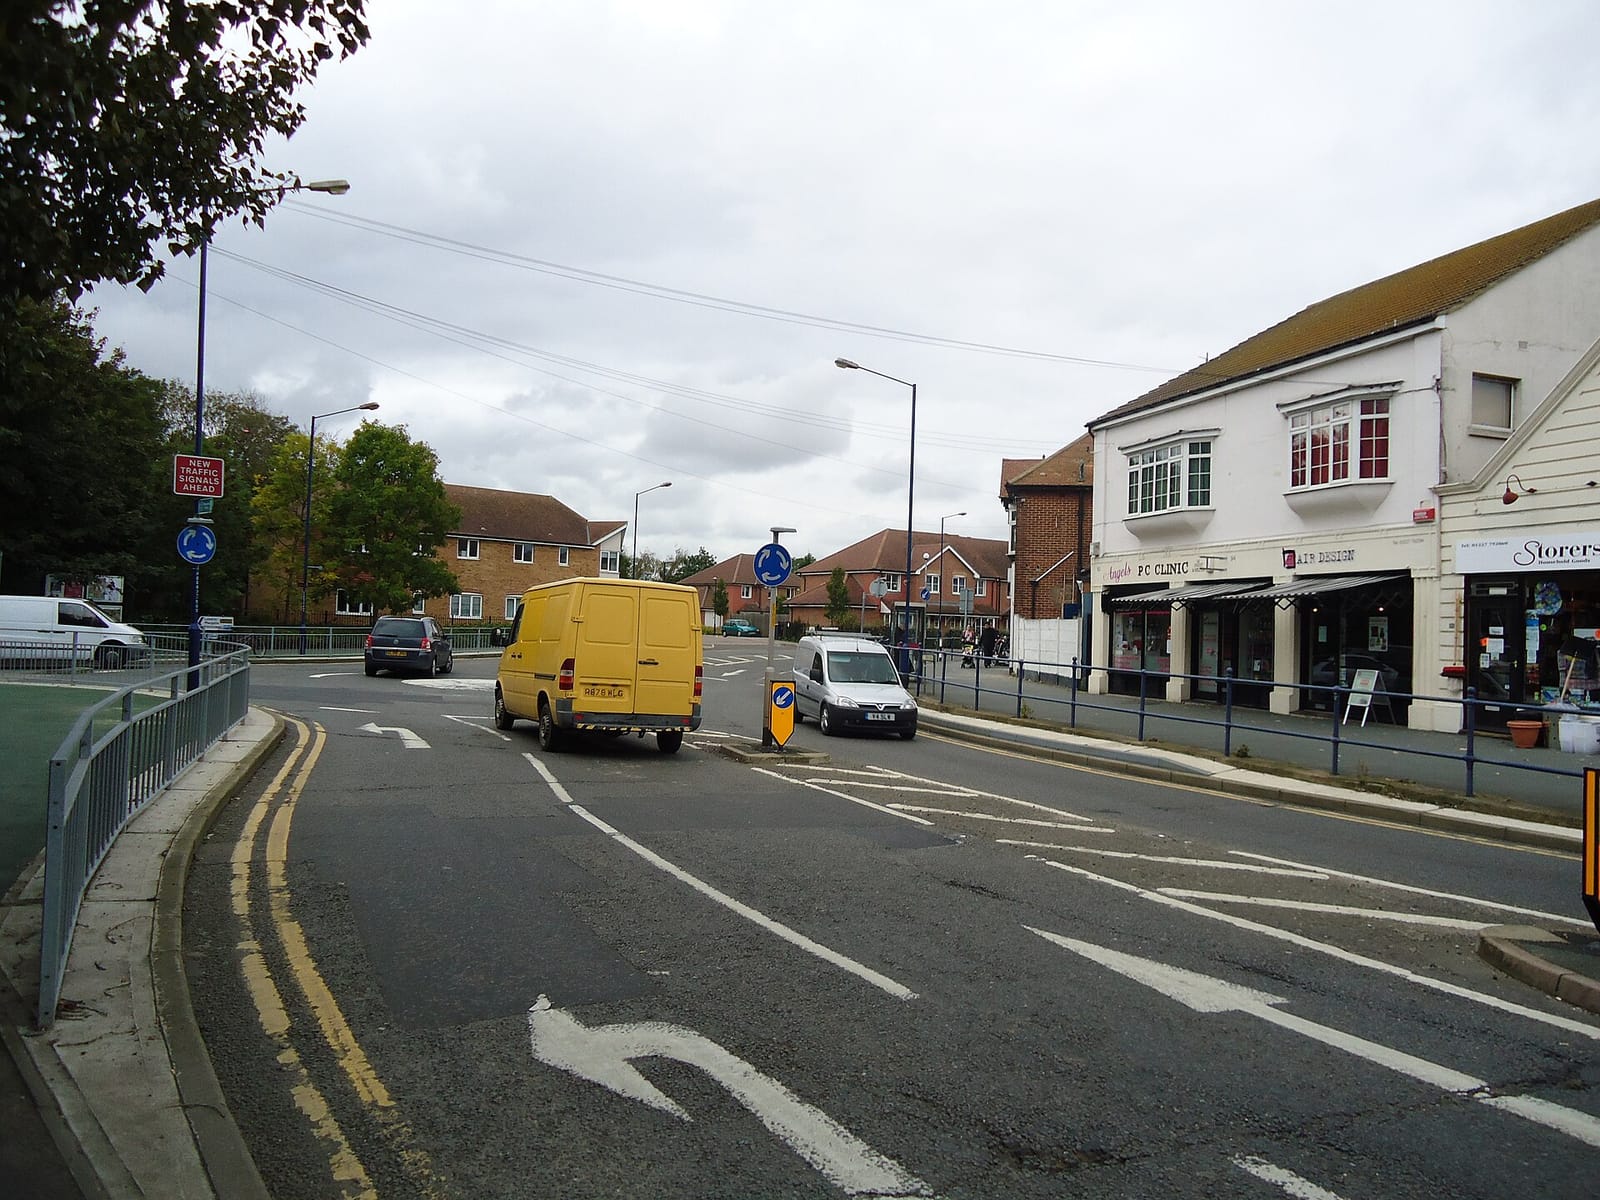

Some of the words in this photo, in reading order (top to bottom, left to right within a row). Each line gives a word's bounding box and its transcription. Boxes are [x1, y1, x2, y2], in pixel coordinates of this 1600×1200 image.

[189, 460, 210, 468] NEW
[180, 467, 218, 477] TRAFFIC
[179, 475, 219, 485] SIGNALS
[183, 484, 215, 493] AHEAD
[1318, 550, 1356, 564] DESIGN
[1513, 540, 1600, 566] Storers
[1138, 564, 1151, 577] PC
[1154, 561, 1189, 576] CLINIC
